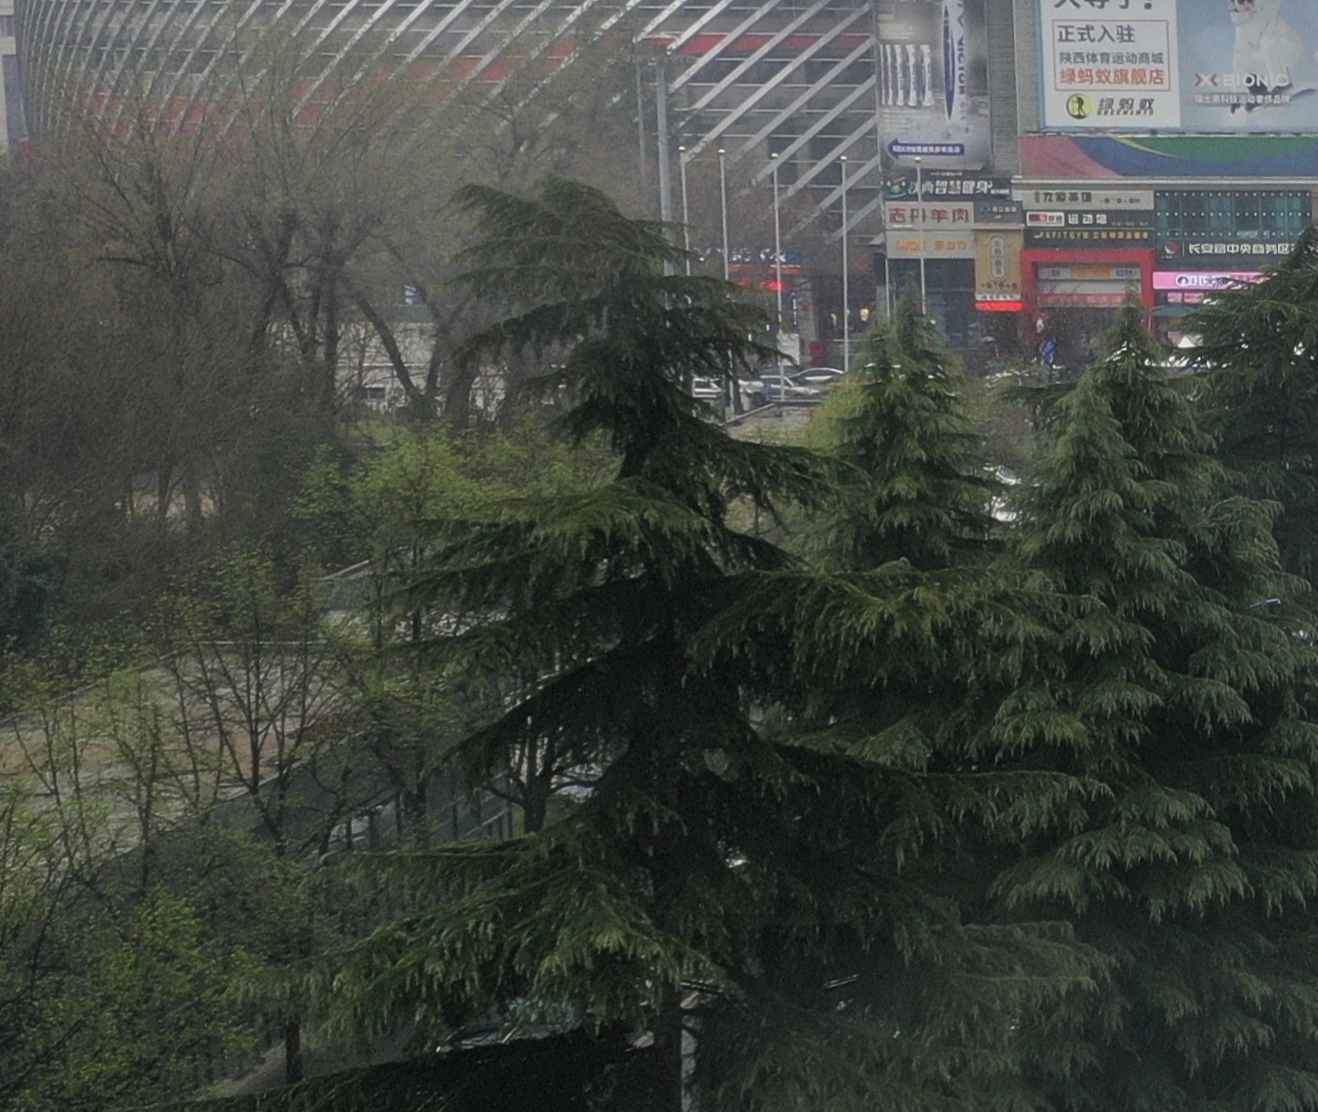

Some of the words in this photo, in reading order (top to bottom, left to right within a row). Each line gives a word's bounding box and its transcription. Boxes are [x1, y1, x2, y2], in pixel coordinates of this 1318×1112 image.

[1057, 24, 1136, 44] 正式入驻
[1059, 67, 1165, 87] 绿蚂蚁旗舰店
[888, 207, 969, 223] 志丹羊肉
